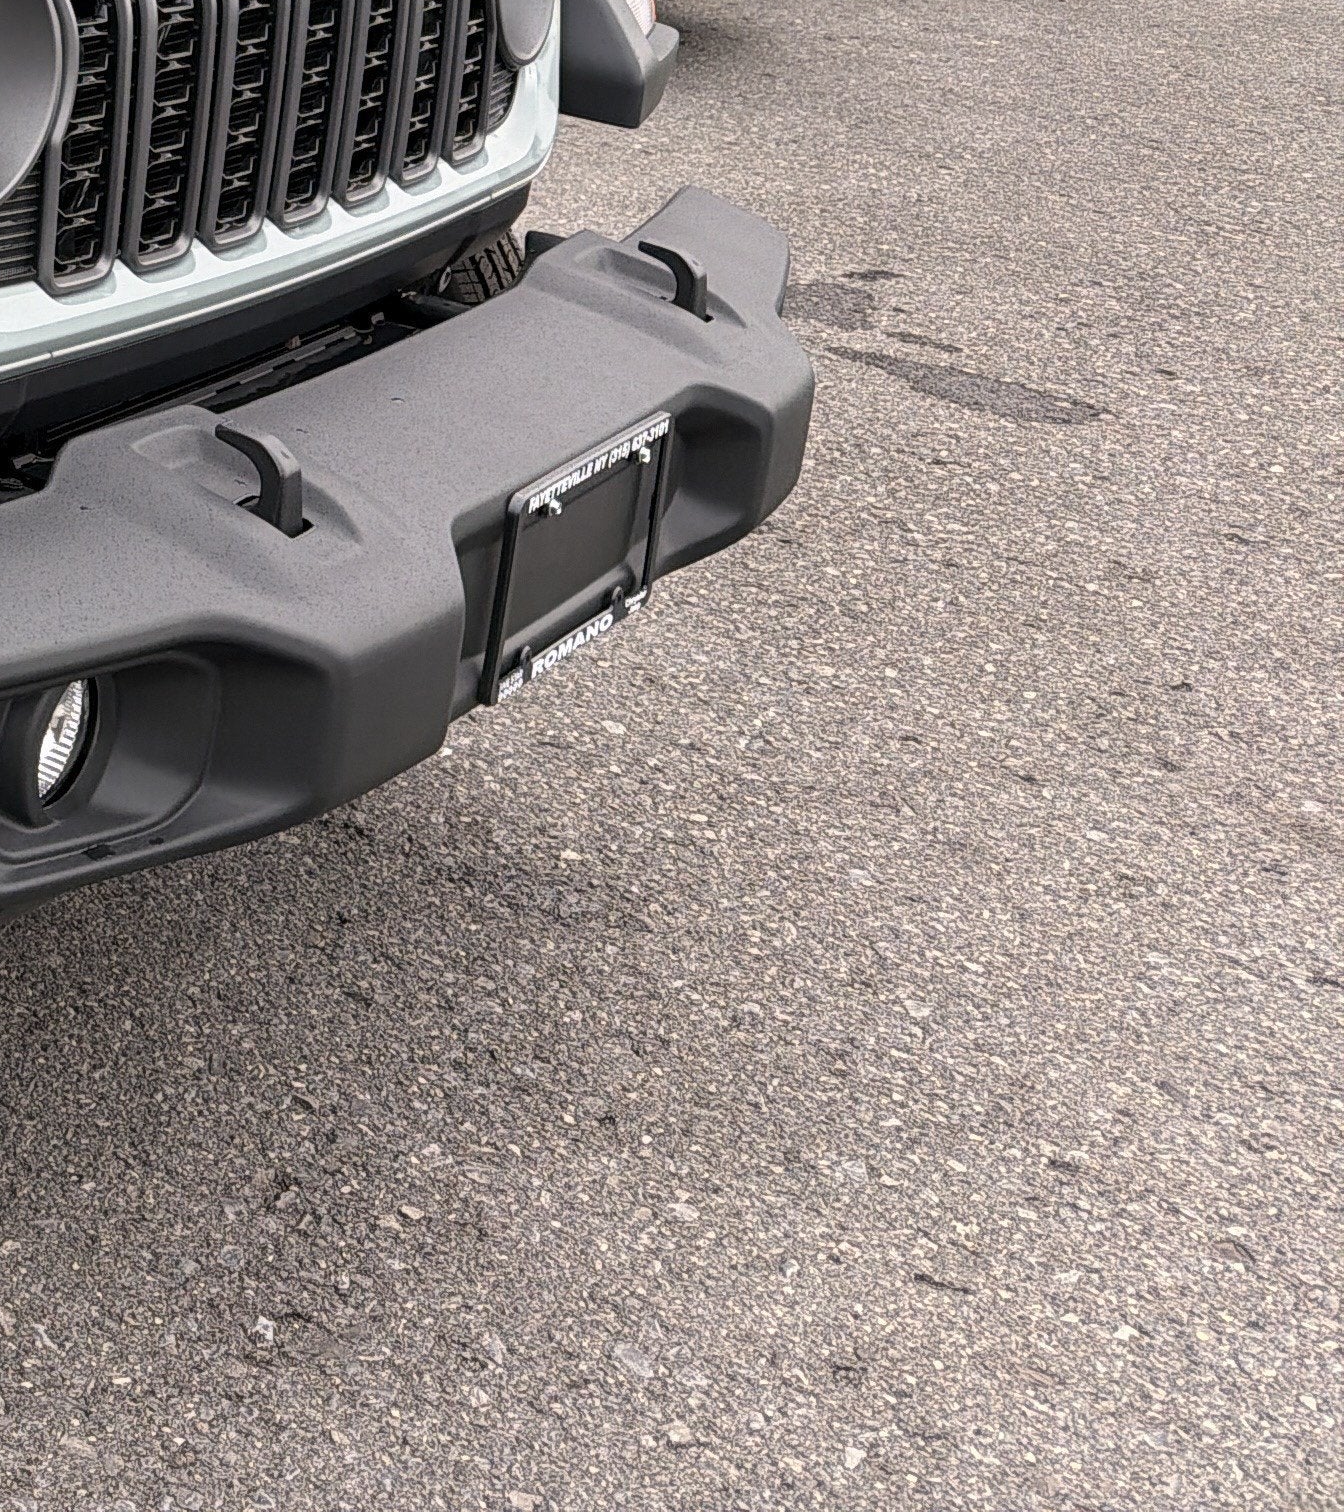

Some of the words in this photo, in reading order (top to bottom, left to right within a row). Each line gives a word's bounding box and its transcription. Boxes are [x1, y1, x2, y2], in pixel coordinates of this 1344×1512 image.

[528, 461, 594, 514] FAYETTEVILLE
[593, 453, 609, 474] NY
[608, 441, 631, 469] (315)
[531, 613, 614, 679] ROMANO
